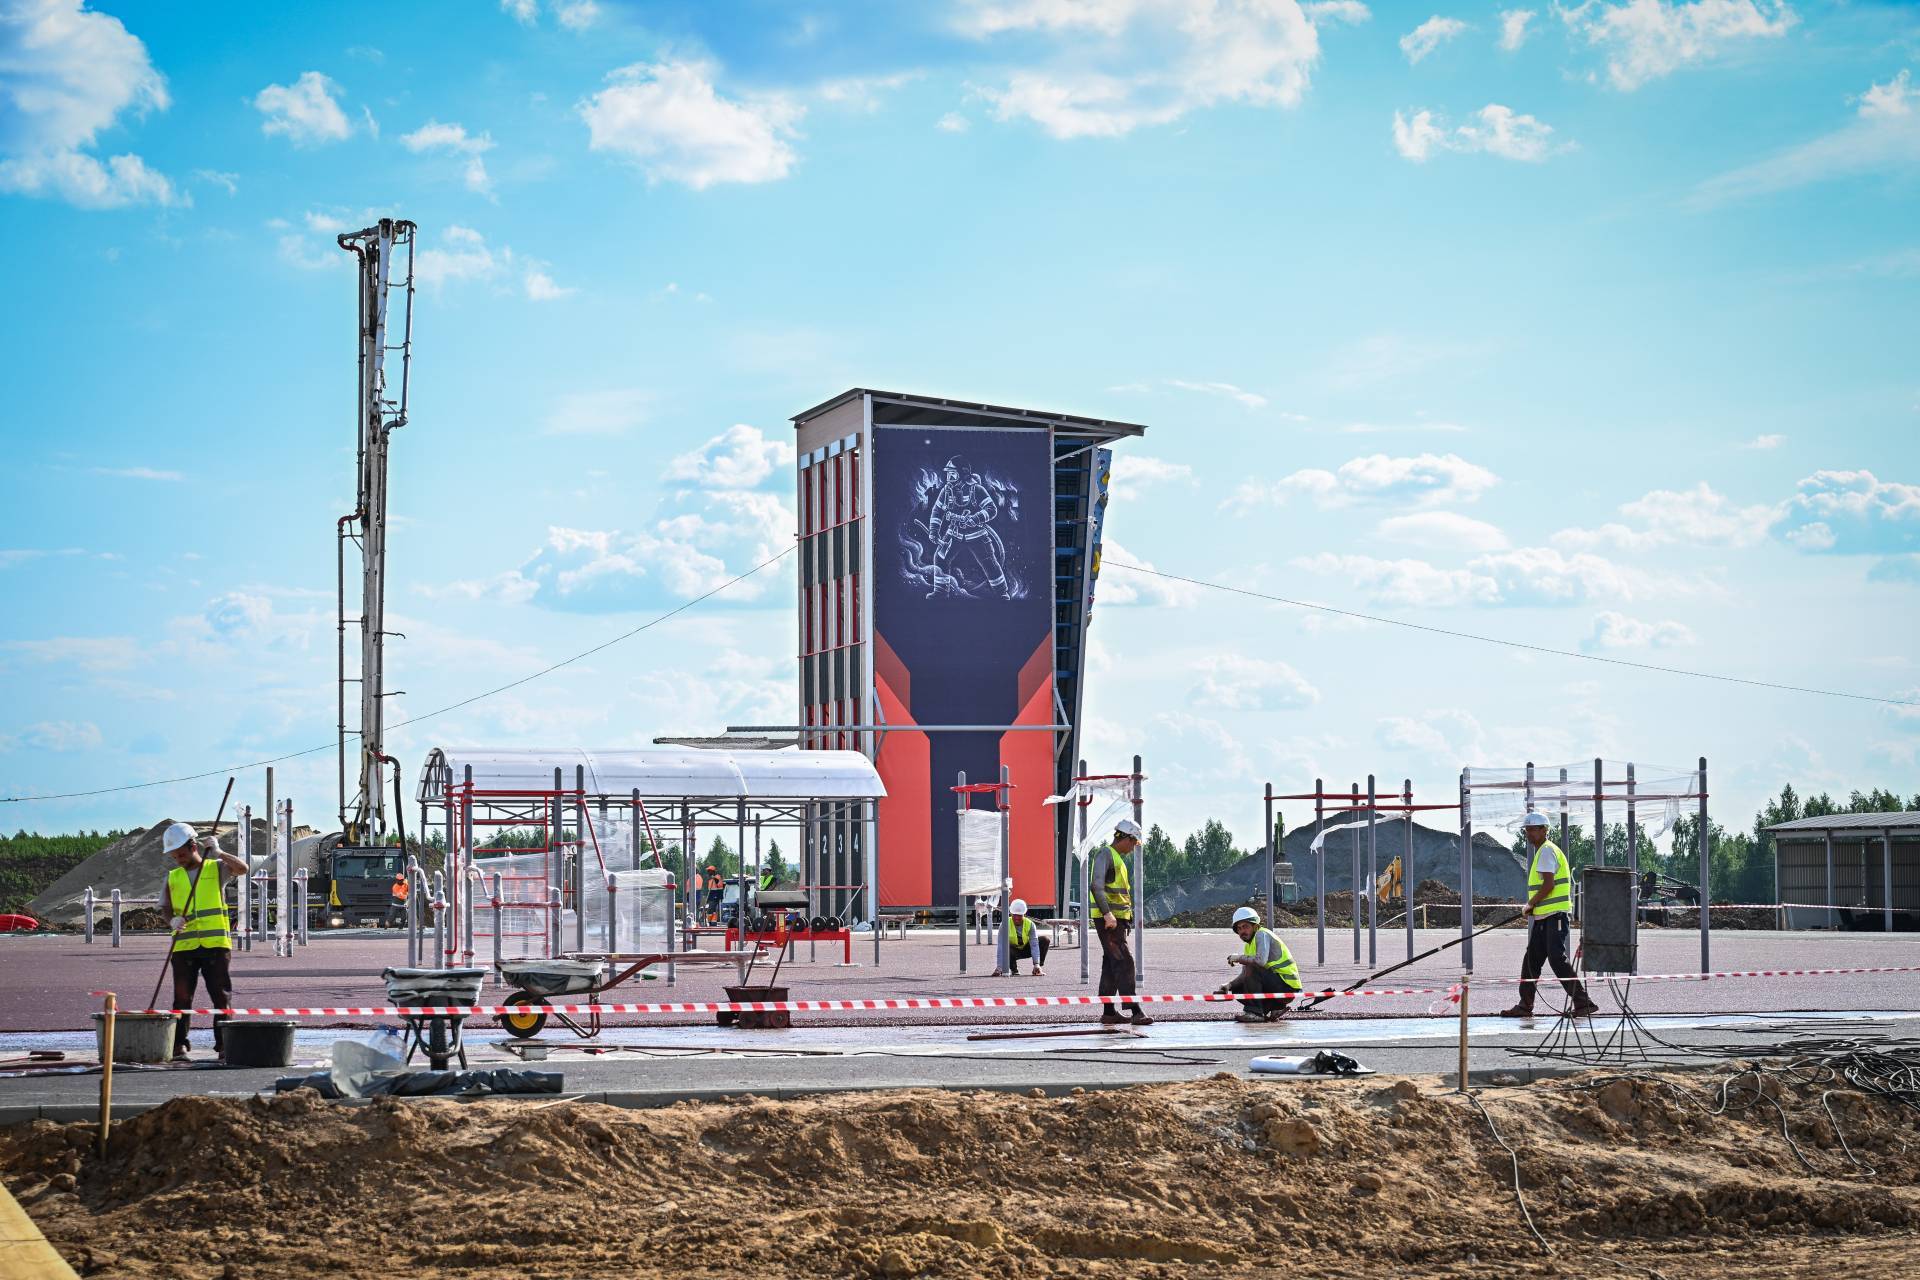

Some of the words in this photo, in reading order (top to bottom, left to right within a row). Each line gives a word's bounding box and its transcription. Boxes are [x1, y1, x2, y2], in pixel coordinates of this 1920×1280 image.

[822, 834, 828, 854] 2
[838, 833, 843, 854] 3
[853, 832, 859, 853] 4
